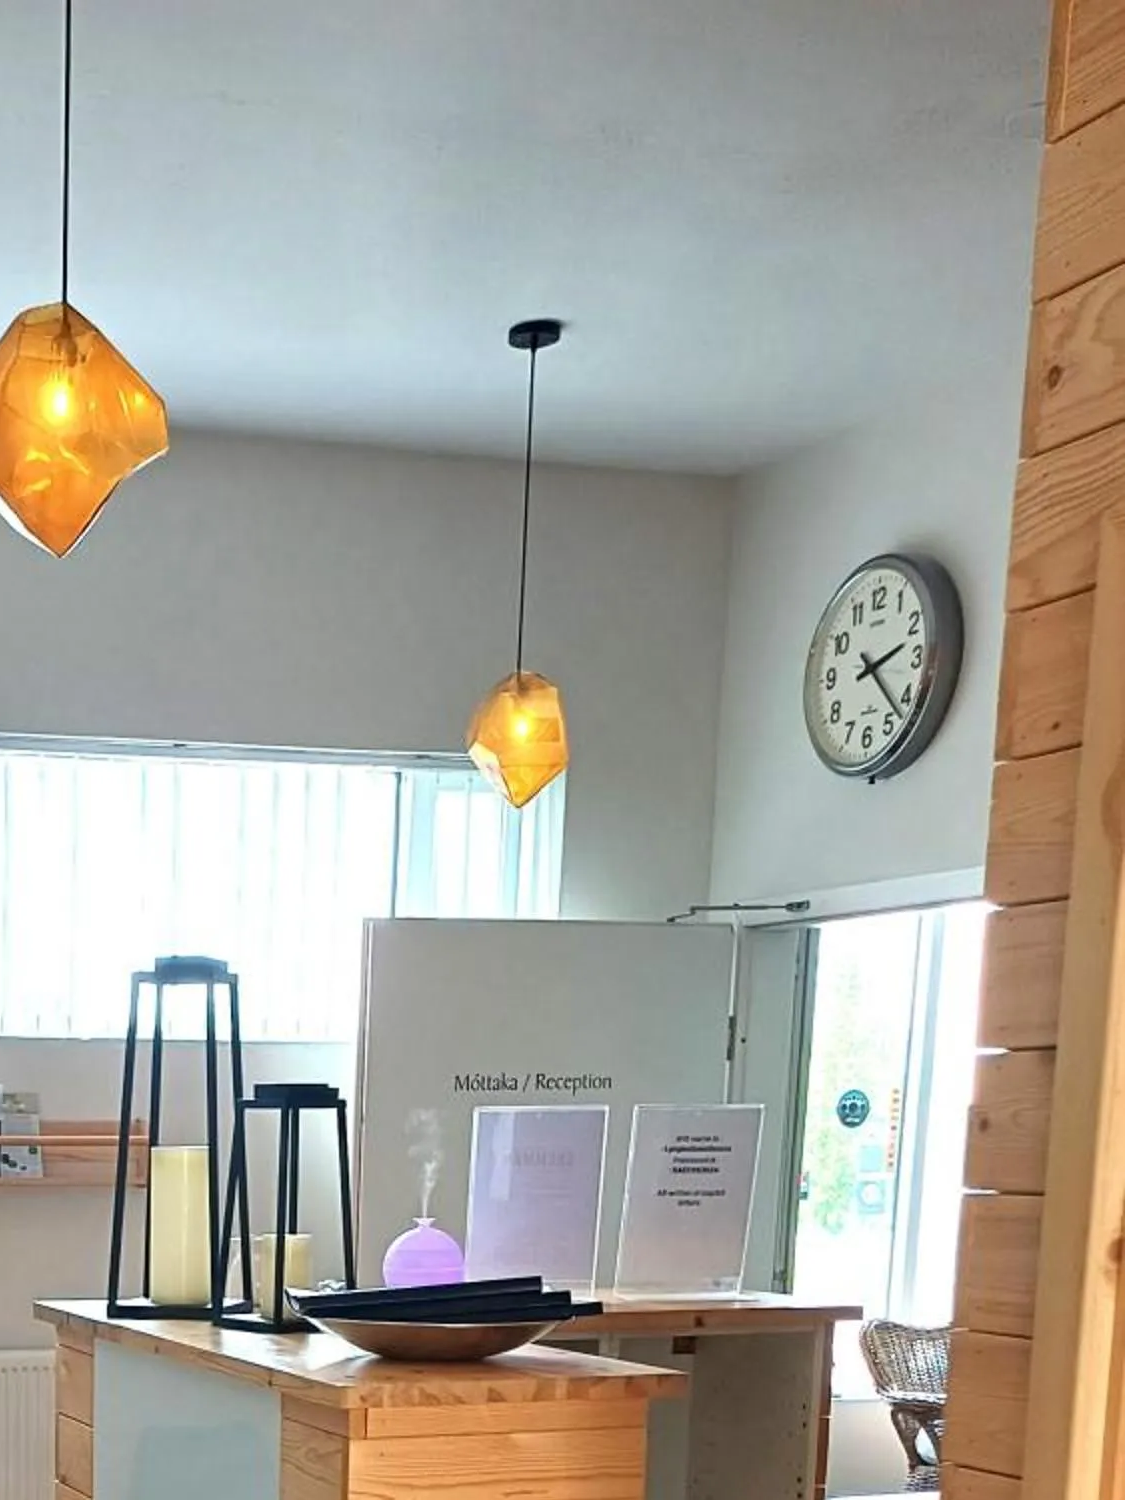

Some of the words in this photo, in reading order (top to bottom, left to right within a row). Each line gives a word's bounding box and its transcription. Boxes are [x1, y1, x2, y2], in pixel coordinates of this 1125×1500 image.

[872, 586, 887, 611] 12
[896, 590, 904, 615] 1
[852, 602, 864, 627] 11
[908, 612, 920, 636] 2
[834, 632, 850, 656] 10
[910, 645, 923, 669] 3
[826, 667, 837, 691] 9
[900, 683, 912, 706] 4
[830, 700, 841, 724] 8
[882, 712, 894, 736] 5
[844, 721, 856, 744] 7
[861, 725, 873, 749] 6
[454, 1072, 518, 1092] Móttaka
[535, 1072, 612, 1096] Reception
